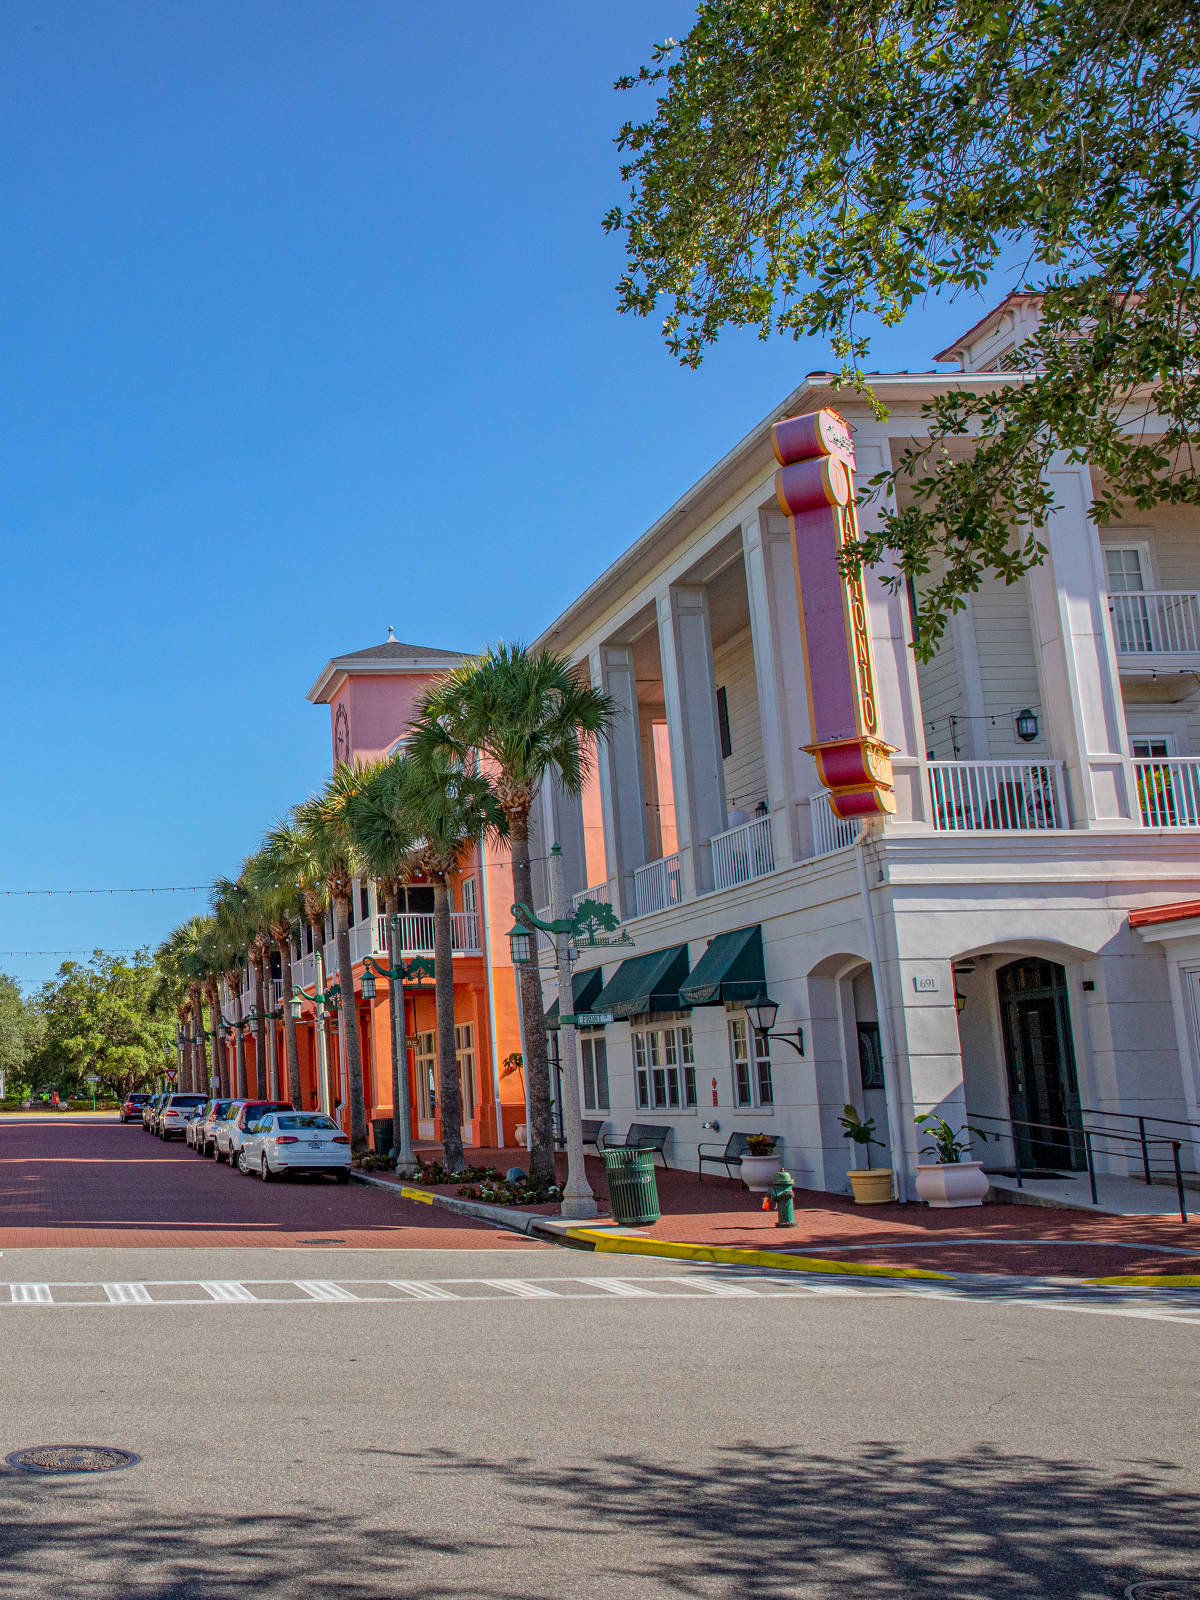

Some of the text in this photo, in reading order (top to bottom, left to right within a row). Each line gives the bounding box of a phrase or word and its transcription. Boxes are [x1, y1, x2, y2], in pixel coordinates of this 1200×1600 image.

[845, 507, 874, 727] AONIO
[919, 978, 935, 989] 691
[582, 1014, 601, 1024] FRONT
